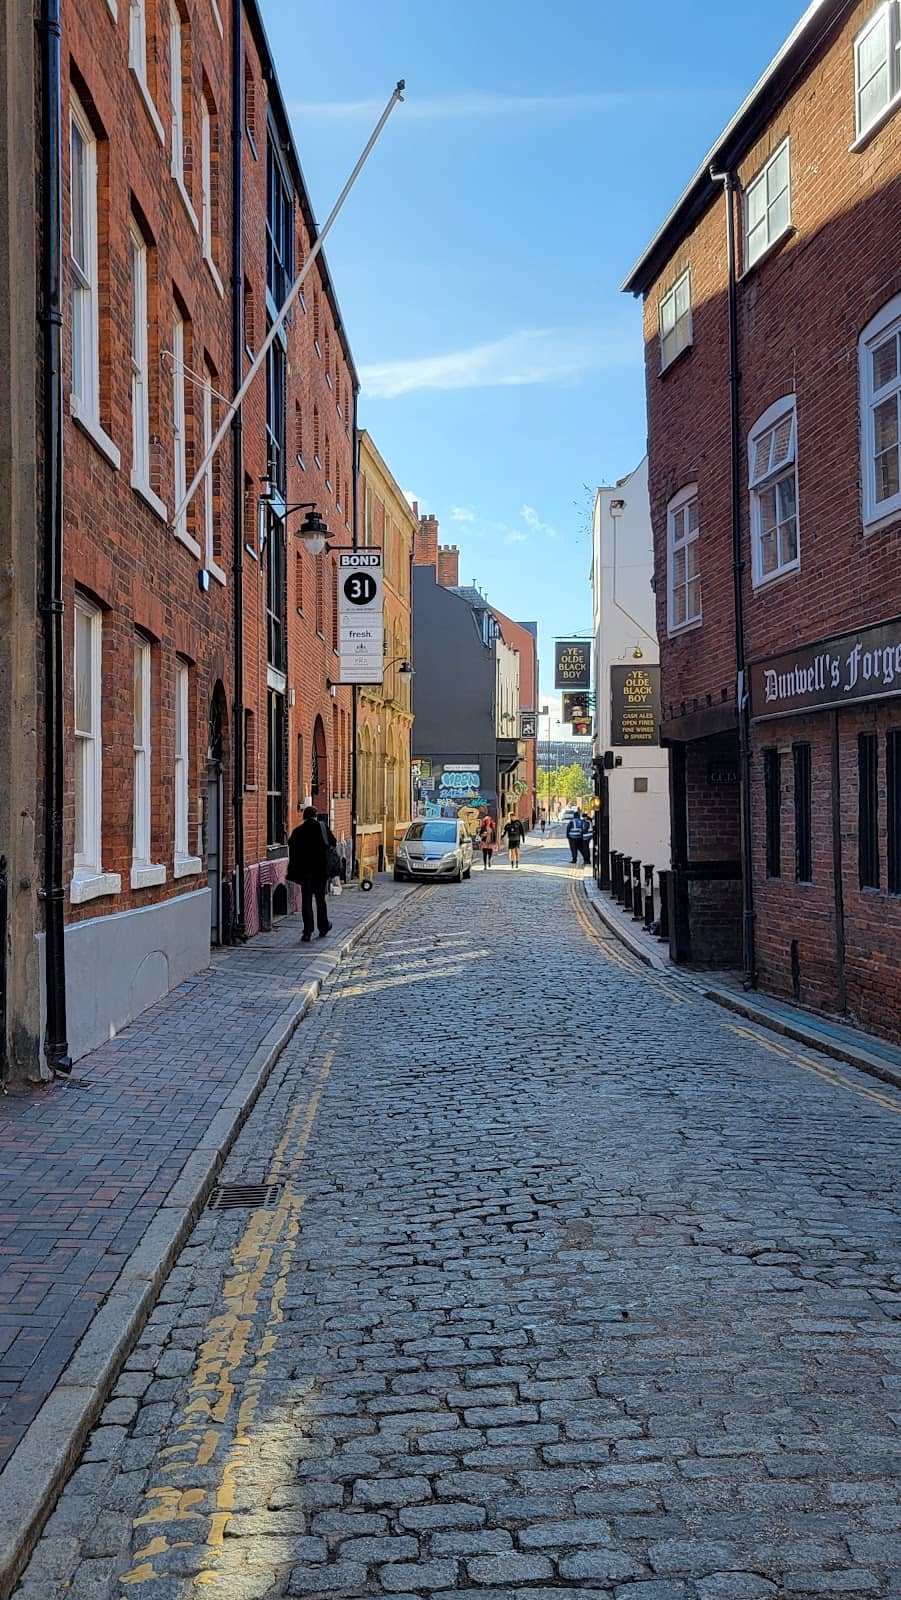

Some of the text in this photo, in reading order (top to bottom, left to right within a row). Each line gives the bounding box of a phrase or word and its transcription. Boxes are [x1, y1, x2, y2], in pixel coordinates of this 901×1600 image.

[342, 556, 379, 566] BOND
[351, 580, 369, 598] 31
[349, 630, 373, 638] fresh.
[763, 654, 841, 704] Dunwell's
